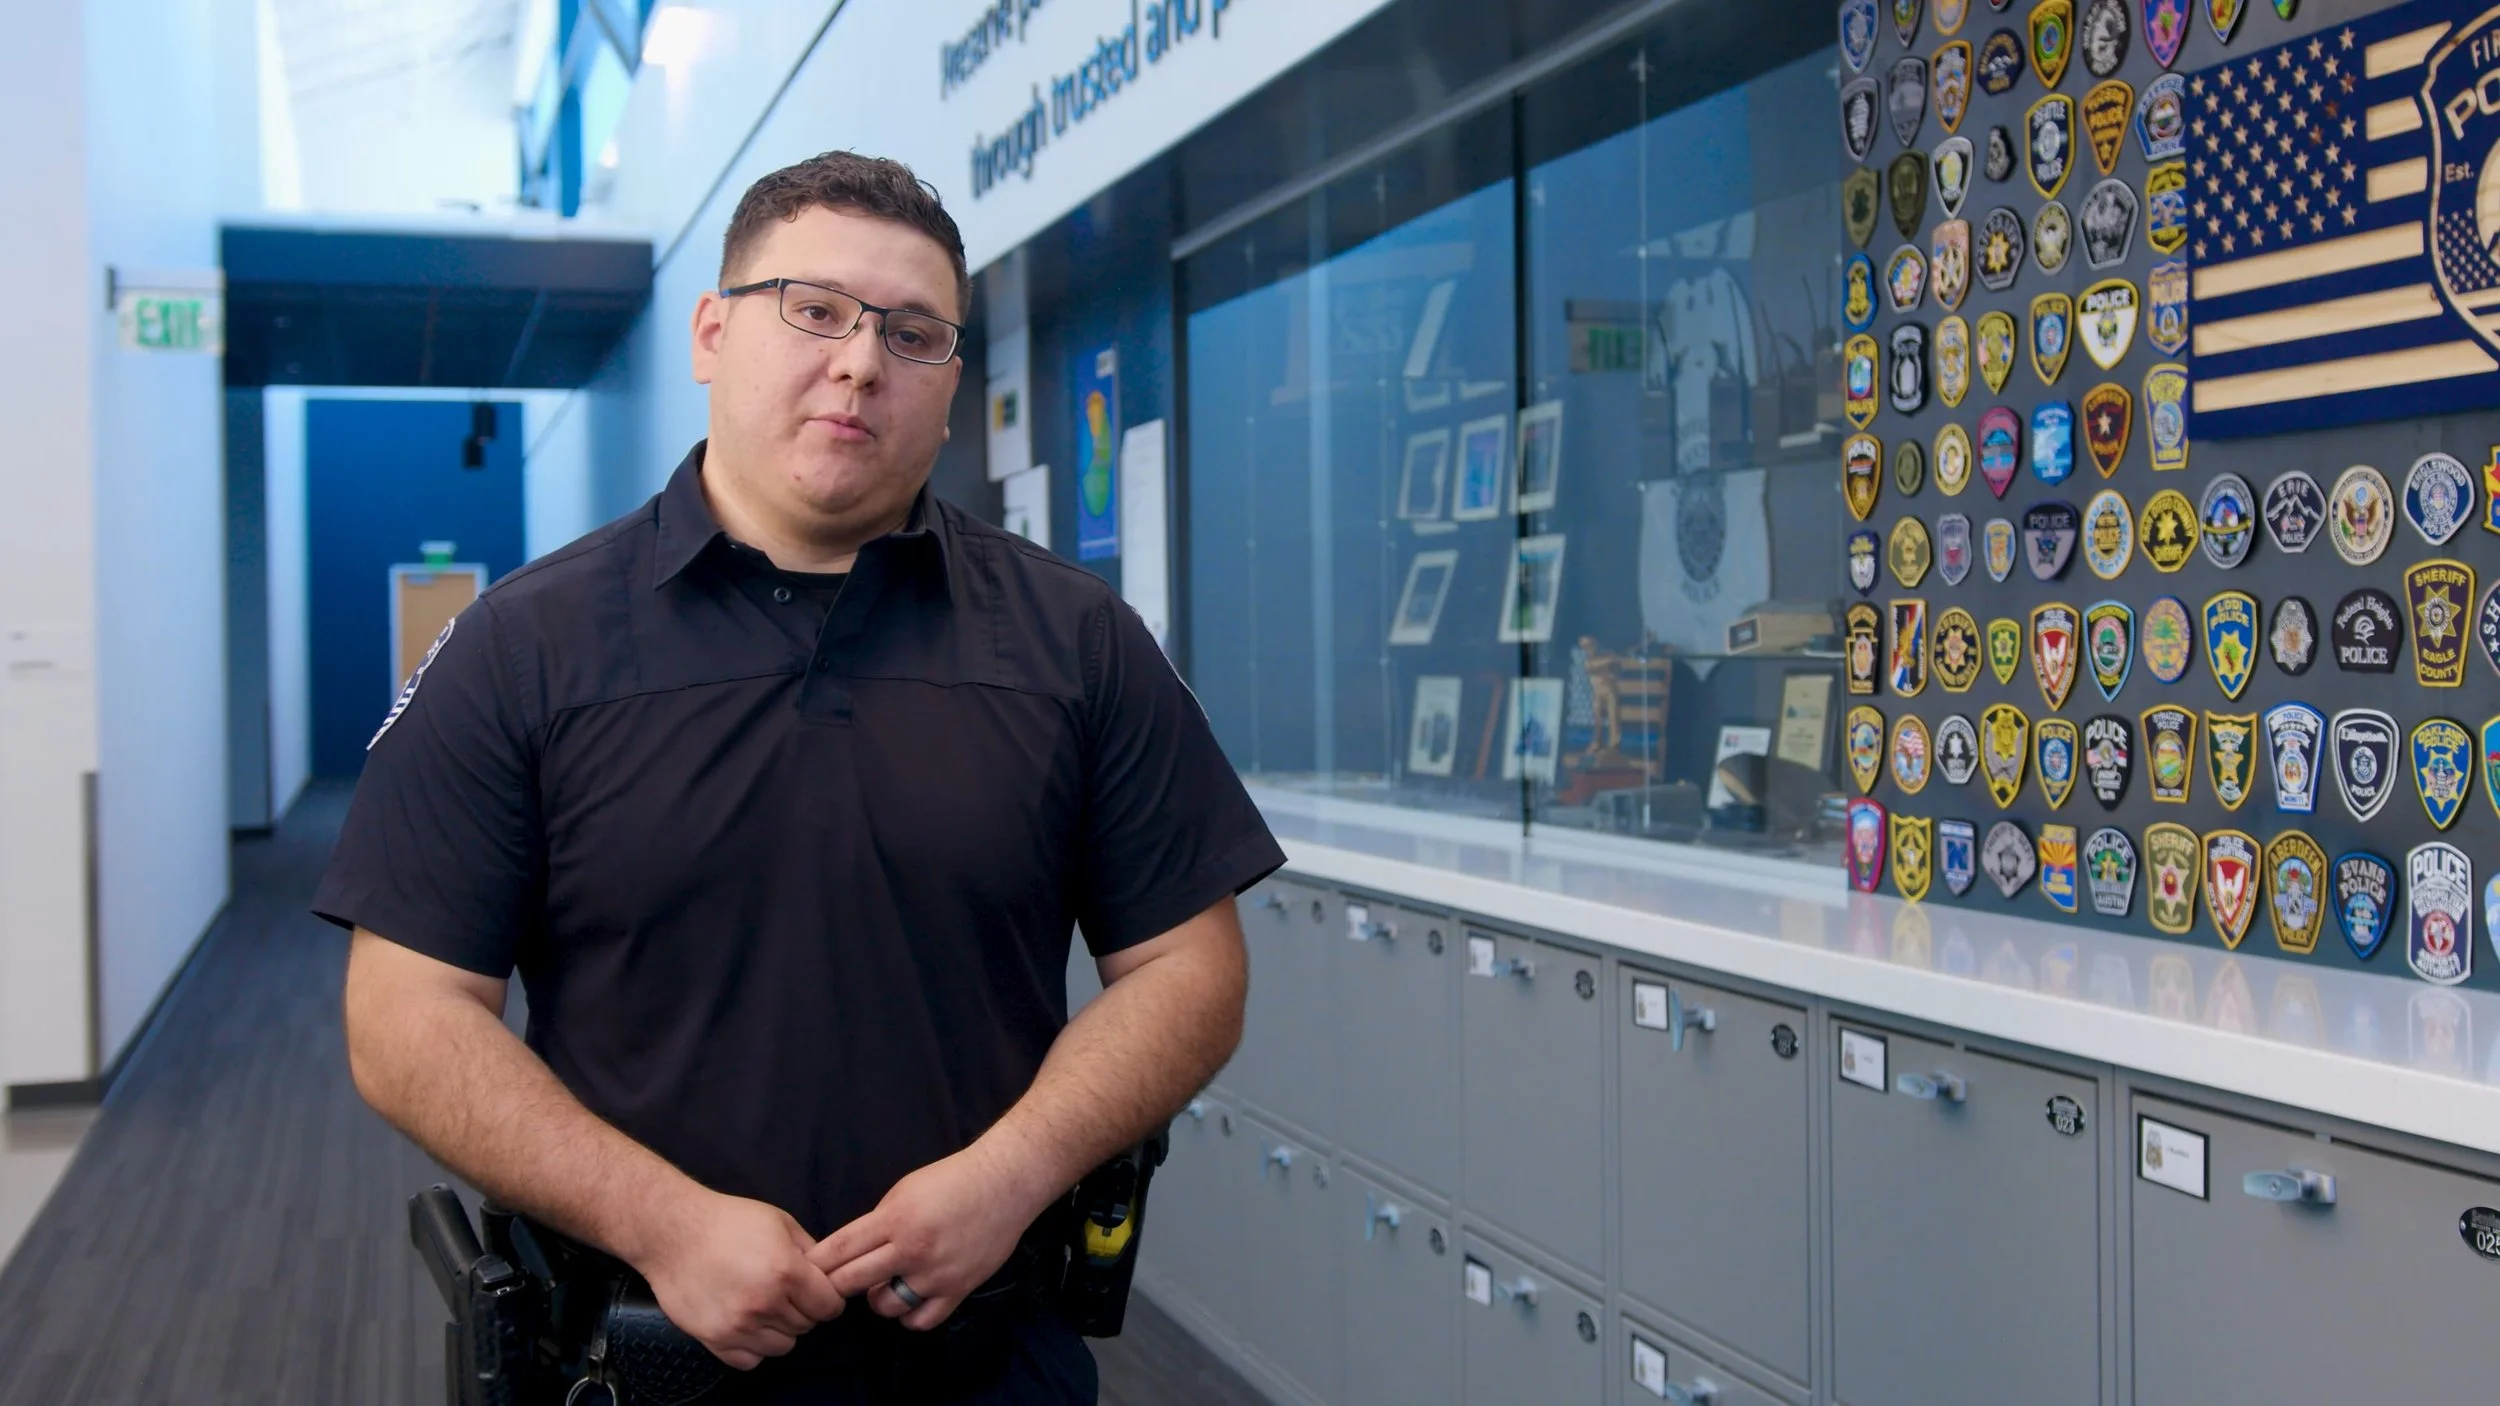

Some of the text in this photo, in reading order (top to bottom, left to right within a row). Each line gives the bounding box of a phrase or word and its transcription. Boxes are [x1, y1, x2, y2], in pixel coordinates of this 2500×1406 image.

[971, 80, 1047, 200] through
[1052, 0, 1137, 136] trusted
[2445, 160, 2474, 183] Est.
[2085, 287, 2131, 313] POLICE
[136, 298, 202, 348] EXIT
[2411, 460, 2467, 491] ENGLEWOOD
[2277, 479, 2310, 499] ERIE
[2029, 512, 2071, 529] POLICE
[2422, 518, 2456, 536] POLICE
[2281, 532, 2306, 544] POLICE
[2414, 567, 2467, 588] SHERIFF
[2210, 610, 2250, 632] POLICE
[2336, 596, 2365, 630] Federal
[2341, 646, 2389, 665] POLICE
[2422, 647, 2457, 664] EAGLE
[2420, 662, 2460, 680] COUNTY
[2157, 720, 2180, 732] POLICE
[2282, 711, 2305, 721] POLICE
[2041, 725, 2073, 743] POLICE
[2085, 718, 2128, 751] POLICE
[2416, 725, 2465, 747] OAKLAND
[2424, 738, 2460, 754] POLICE
[2350, 784, 2377, 798] POLICE
[2089, 833, 2132, 863] POLICE
[2150, 832, 2196, 857] SHERIFF
[2269, 838, 2323, 874] ABERDEEN
[2340, 859, 2387, 885] EVANS
[2411, 848, 2468, 889] POLICE
[2098, 894, 2126, 907] AUSTIN
[2338, 878, 2387, 905] POLICE
[2281, 927, 2310, 944] POLICE
[2416, 956, 2461, 978] AUTHORITY
